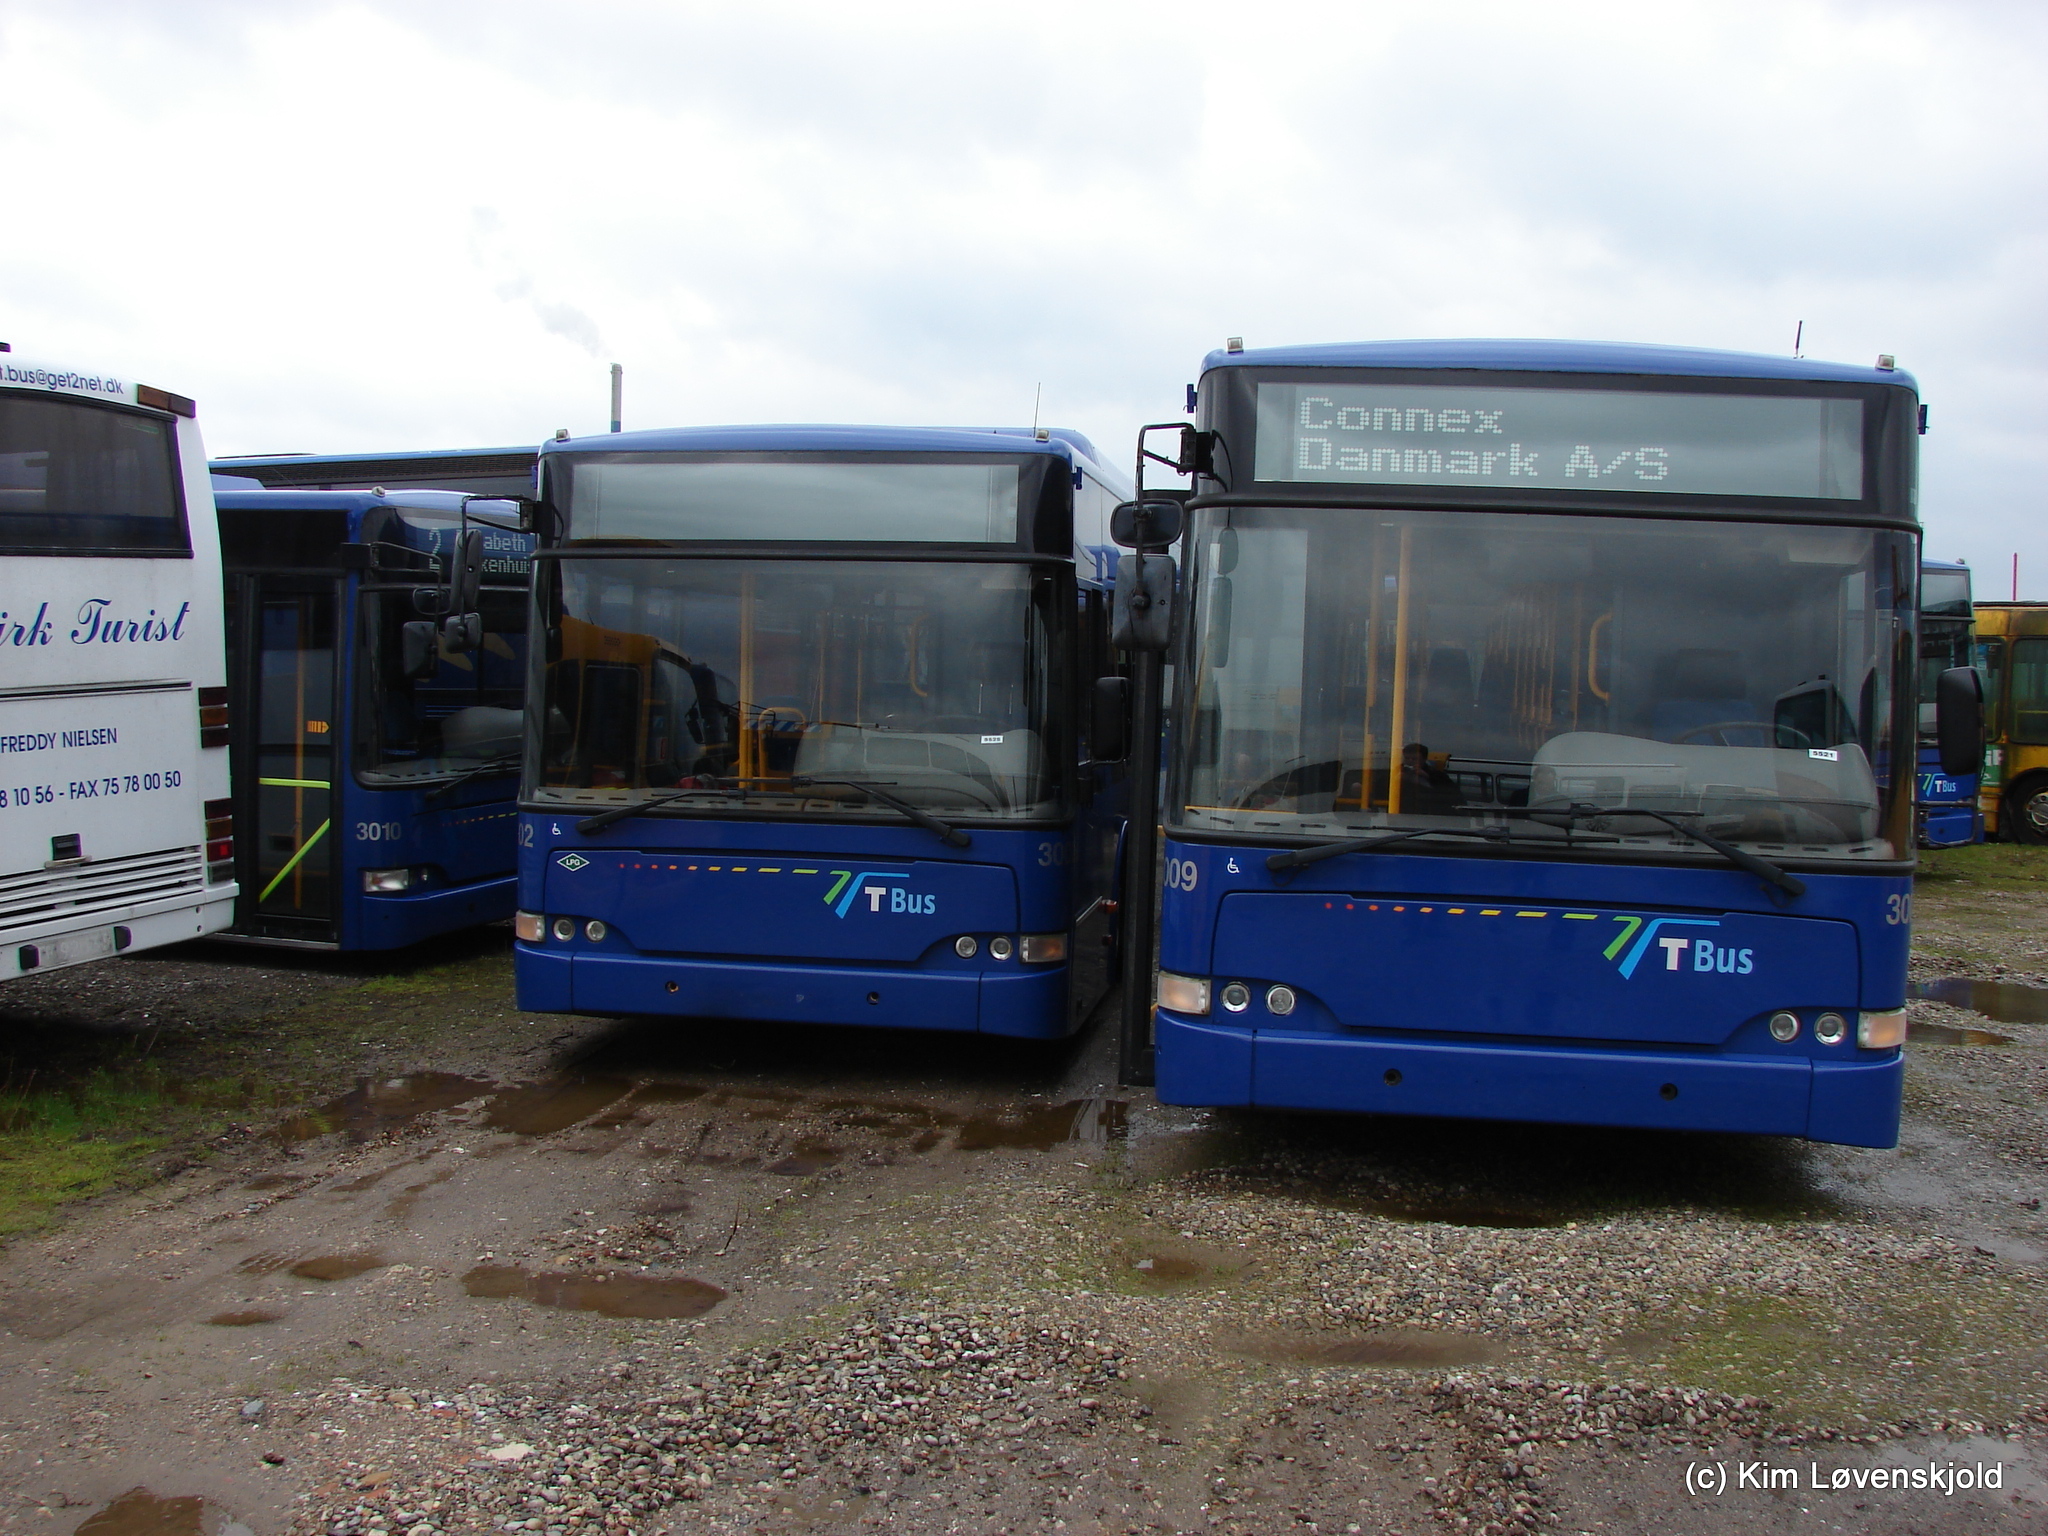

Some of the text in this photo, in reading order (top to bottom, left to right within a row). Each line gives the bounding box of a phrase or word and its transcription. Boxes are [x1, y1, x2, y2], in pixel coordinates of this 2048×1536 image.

[1299, 396, 1503, 434] Connex
[1298, 437, 1669, 480] Danmark A/S
[483, 532, 526, 552] abeth
[71, 598, 190, 645] Turist
[0, 727, 118, 754] FREDDY NIELSEN
[13, 787, 30, 806] 10
[35, 784, 54, 804] 56
[69, 779, 99, 800] FAX
[102, 777, 120, 796] 75
[124, 775, 140, 793] 78
[144, 773, 161, 790] 00
[165, 770, 181, 788] 50
[1942, 780, 1957, 793] Bus
[356, 822, 401, 841] 3010
[864, 886, 936, 915] T Bus
[1659, 937, 1753, 975] T Bus
